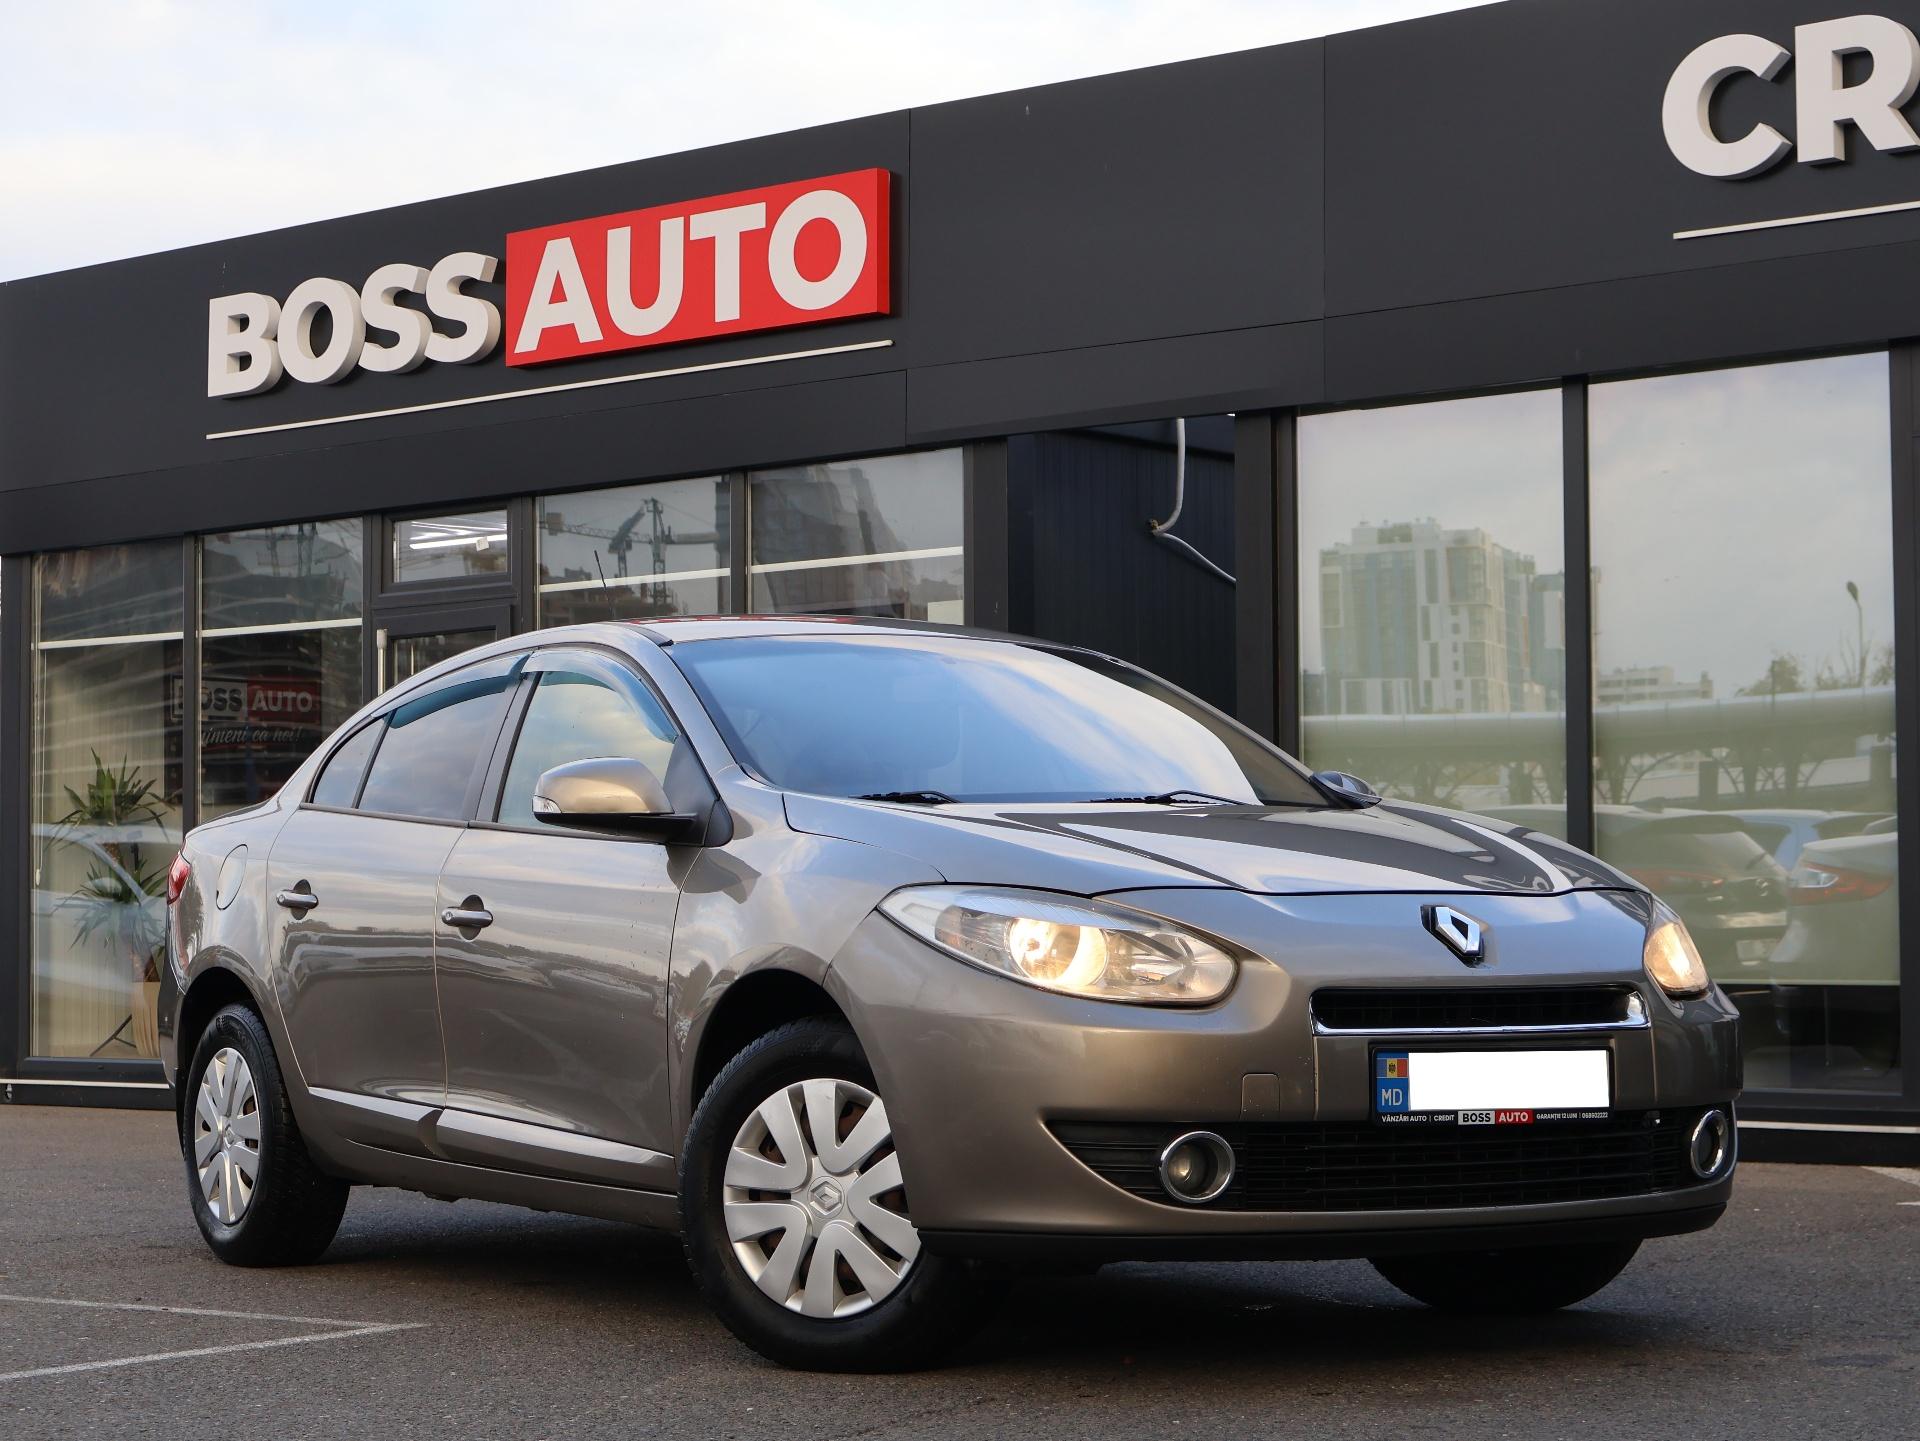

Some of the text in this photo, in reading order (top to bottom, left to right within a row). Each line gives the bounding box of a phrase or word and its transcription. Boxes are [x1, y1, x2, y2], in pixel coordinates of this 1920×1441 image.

[1662, 14, 1920, 181] CR
[208, 190, 867, 398] BOSS AUTO
[178, 686, 313, 713] OSS AUTO
[1381, 1088, 1403, 1106] MD
[1462, 1113, 1491, 1123] BOSS
[1498, 1112, 1529, 1122] AUTO
